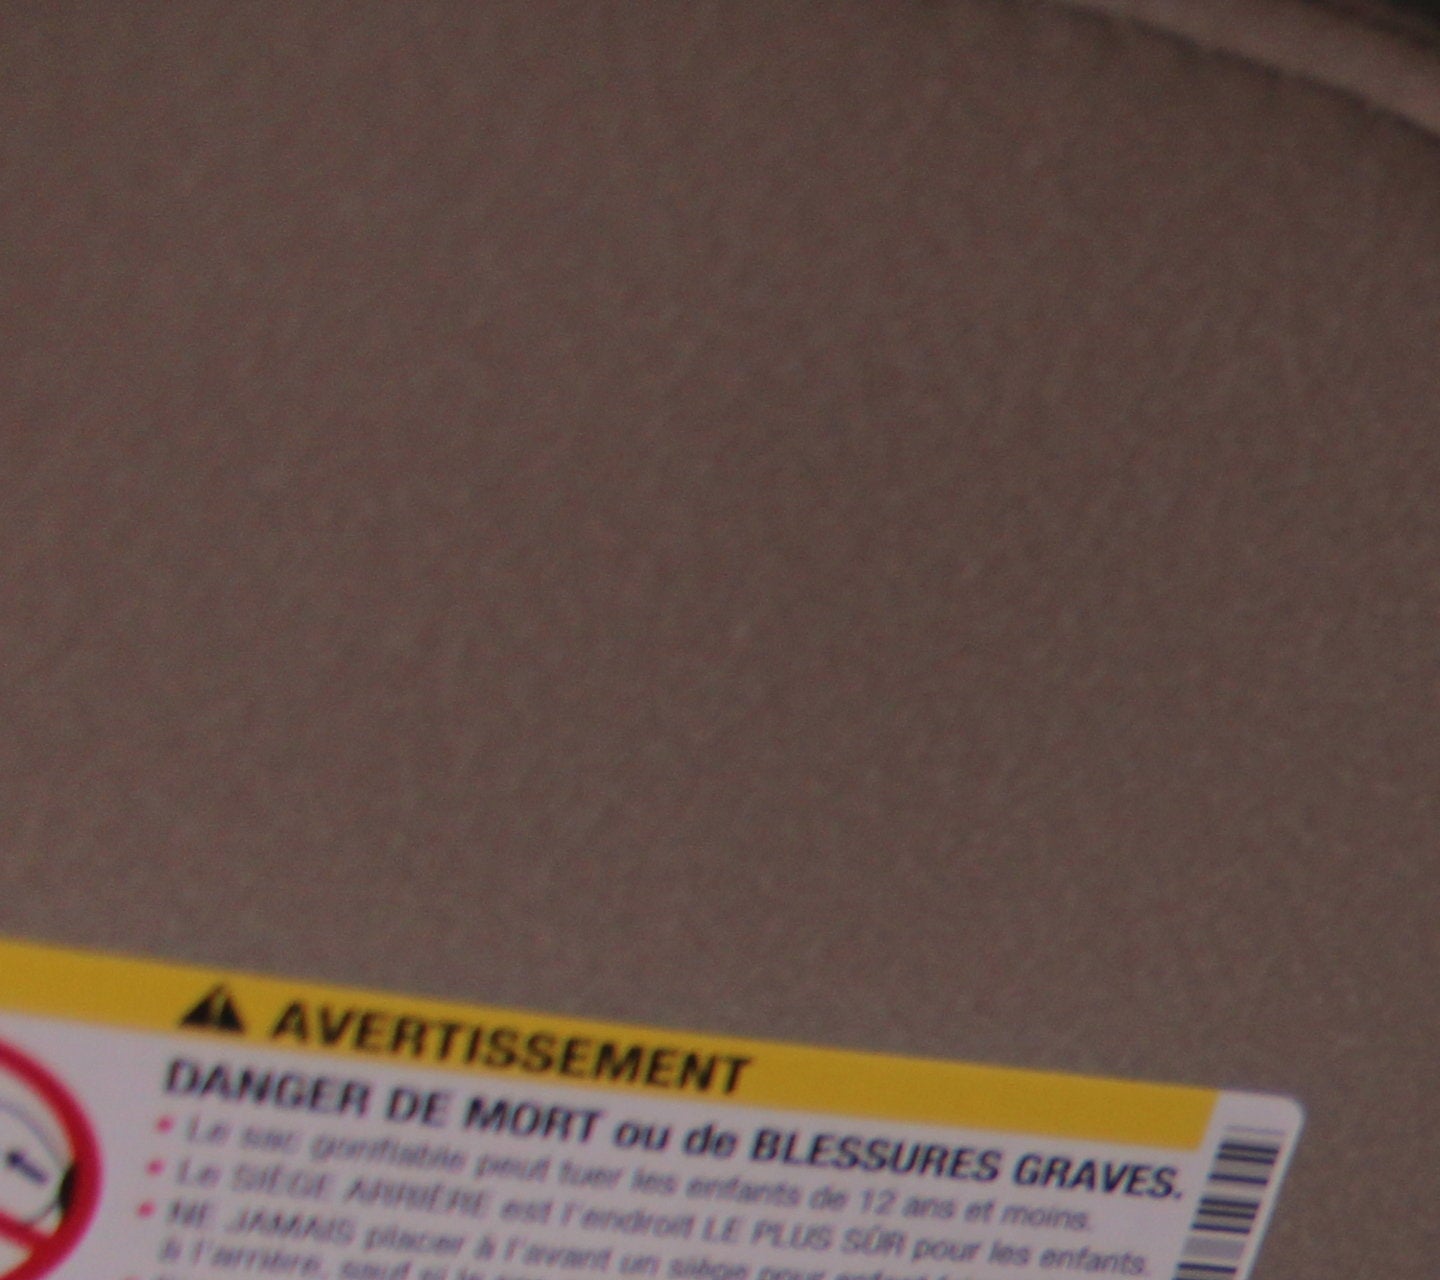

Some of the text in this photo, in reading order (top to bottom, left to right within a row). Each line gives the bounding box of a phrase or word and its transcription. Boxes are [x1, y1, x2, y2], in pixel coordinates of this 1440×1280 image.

[271, 1000, 751, 1095] AVERTISSEMENT
[165, 1058, 1182, 1200] DANGER DE MORT ou de BLESSURES GRAVES.
